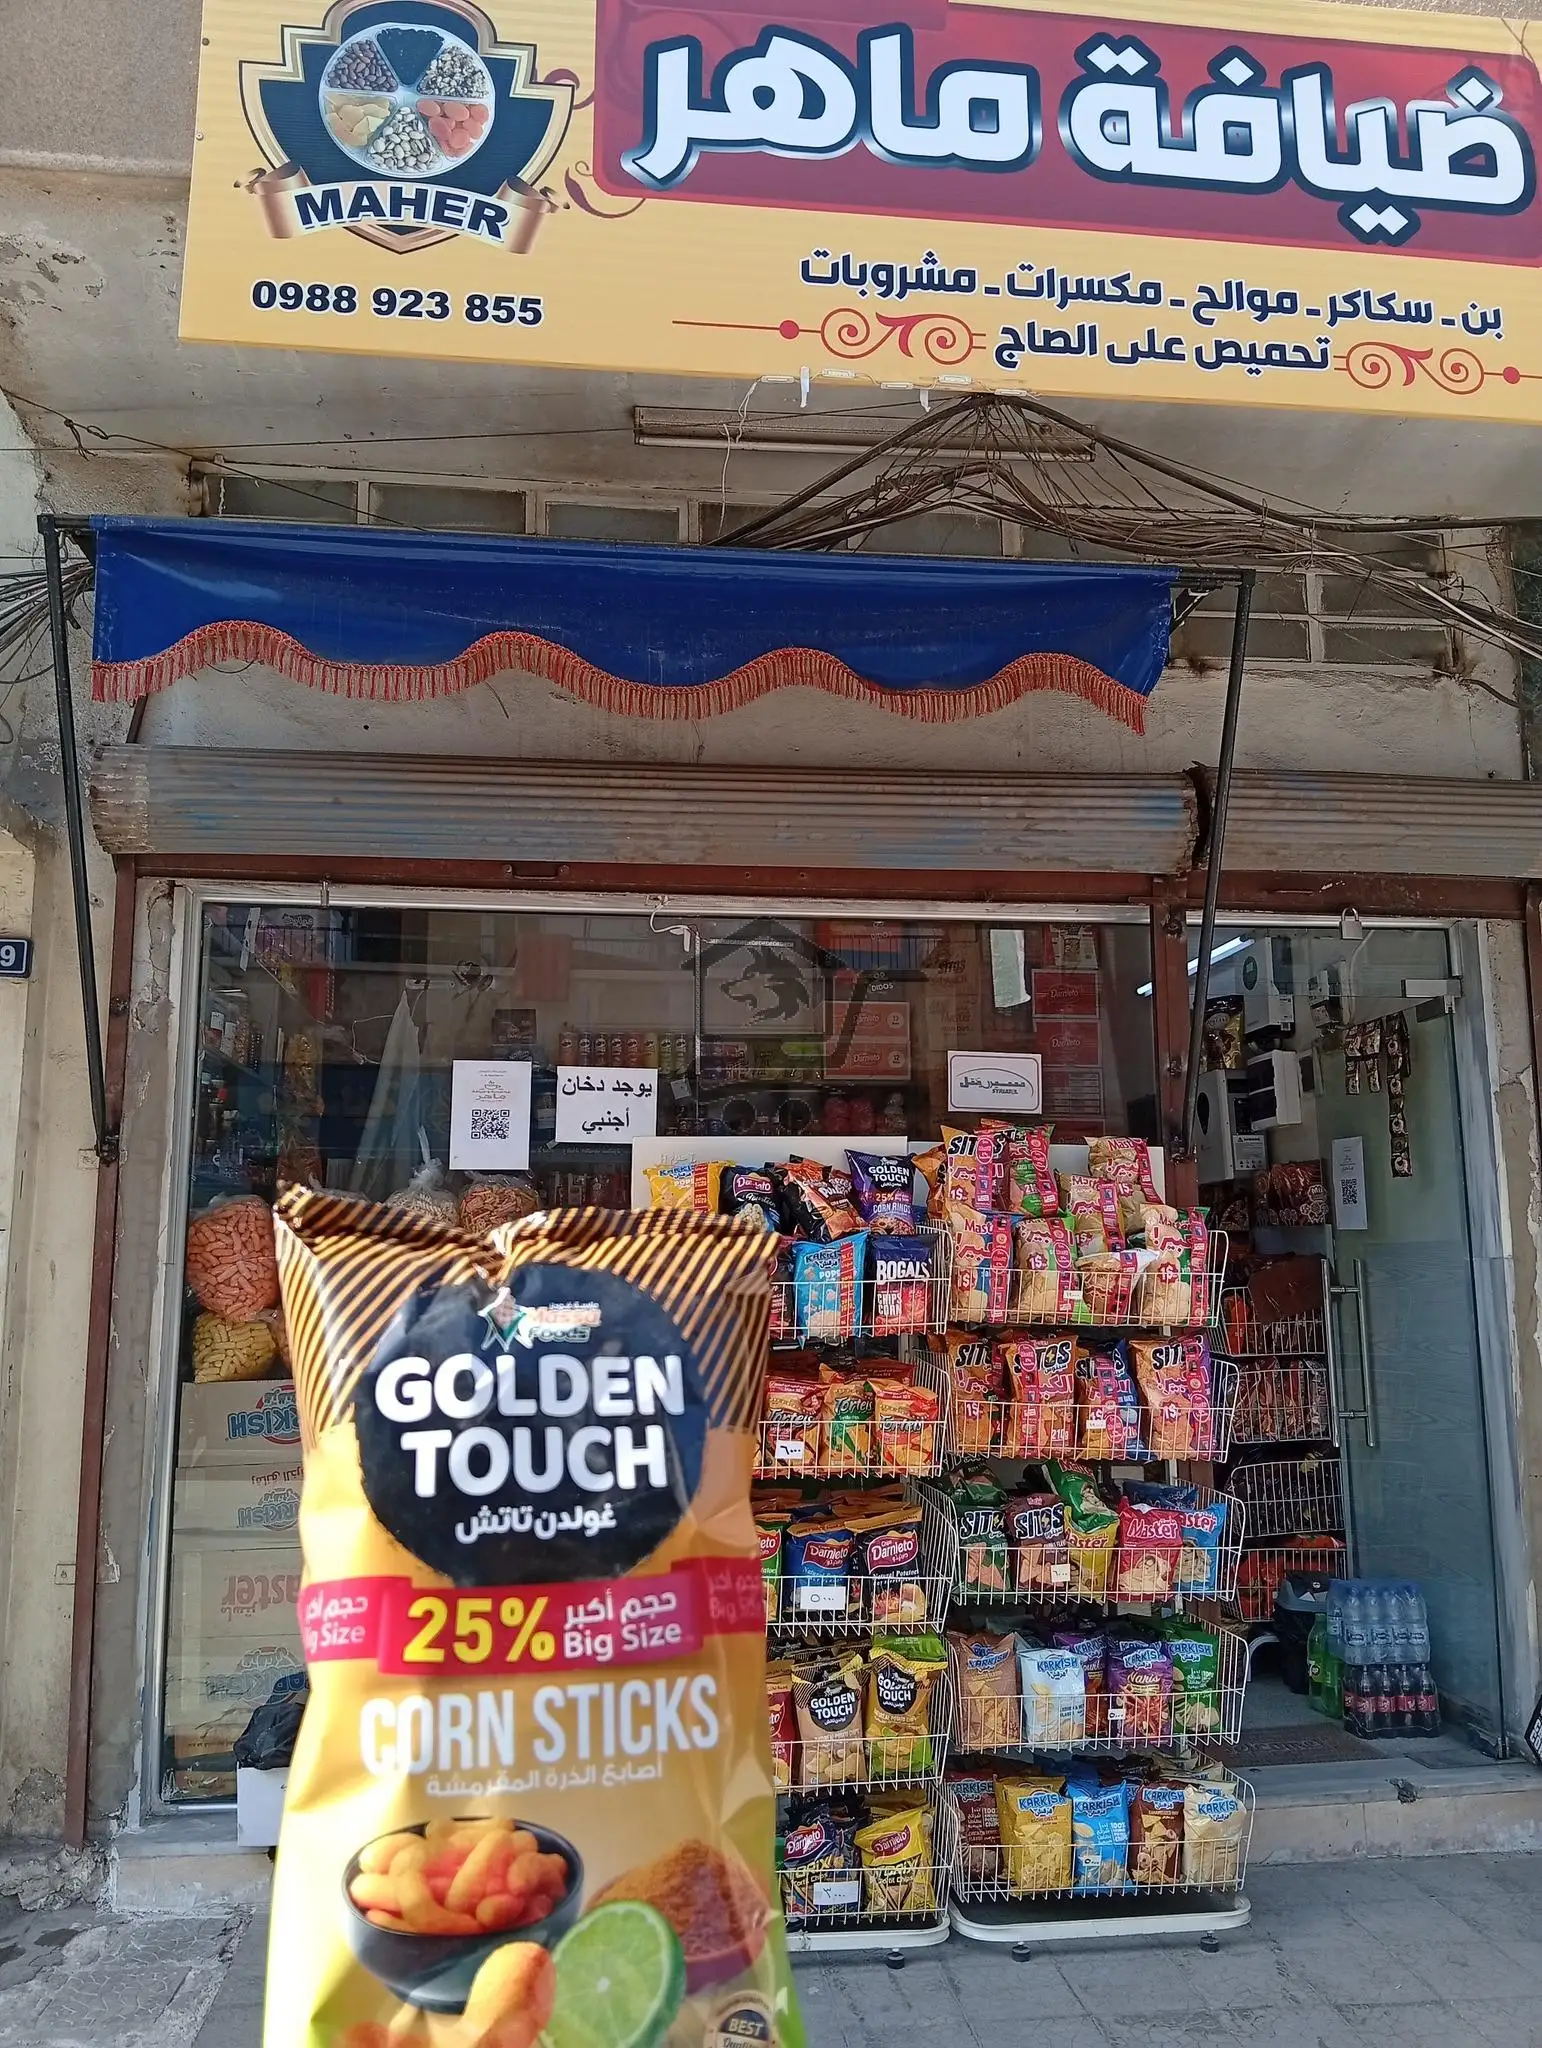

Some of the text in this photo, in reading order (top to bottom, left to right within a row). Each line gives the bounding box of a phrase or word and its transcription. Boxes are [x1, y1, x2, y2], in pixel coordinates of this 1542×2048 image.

[626, 28, 1530, 240] ضيافة ماهر
[295, 185, 512, 242] MAHER
[251, 280, 544, 326] 0988 923 855
[800, 249, 1503, 341] بن سكاكر موالح مكسرات مشروبات
[994, 319, 1330, 377] تحميص على الصاج
[0, 945, 16, 967] 9
[562, 1075, 653, 1098] يوجد دخان
[581, 1106, 630, 1135] أجنبي
[868, 1165, 910, 1177] GOLDEN
[873, 1173, 908, 1185] TOUCH
[873, 1202, 911, 1214] CORN RINGS
[875, 1191, 894, 1202] 25%
[964, 1218, 993, 1234] Mast
[877, 1292, 902, 1305] CHIPS
[374, 1352, 685, 1424] GOLDEN
[400, 1424, 669, 1498] TOUCH
[454, 1505, 617, 1545] غولدن تاتش
[1014, 1502, 1064, 1539] SITOS
[1127, 1517, 1179, 1539] Master
[1180, 1511, 1218, 1534] aster
[221, 1573, 301, 1610] aster
[562, 1588, 678, 1629] حجم أكبر
[320, 1620, 366, 1648] Size
[401, 1594, 558, 1667] 25%
[562, 1620, 683, 1662] Big Size
[1036, 1657, 1079, 1673] KARKISH
[810, 1691, 856, 1709] GOLDEN
[879, 1686, 912, 1702] TOUCH
[358, 1673, 721, 1778] CORN STICKS
[815, 1704, 854, 1720] TOUCH
[425, 1752, 664, 1798] أصابع الذرة المقرمشة
[1197, 1799, 1238, 1815] KARKIS
[727, 2018, 765, 2037] BEST
